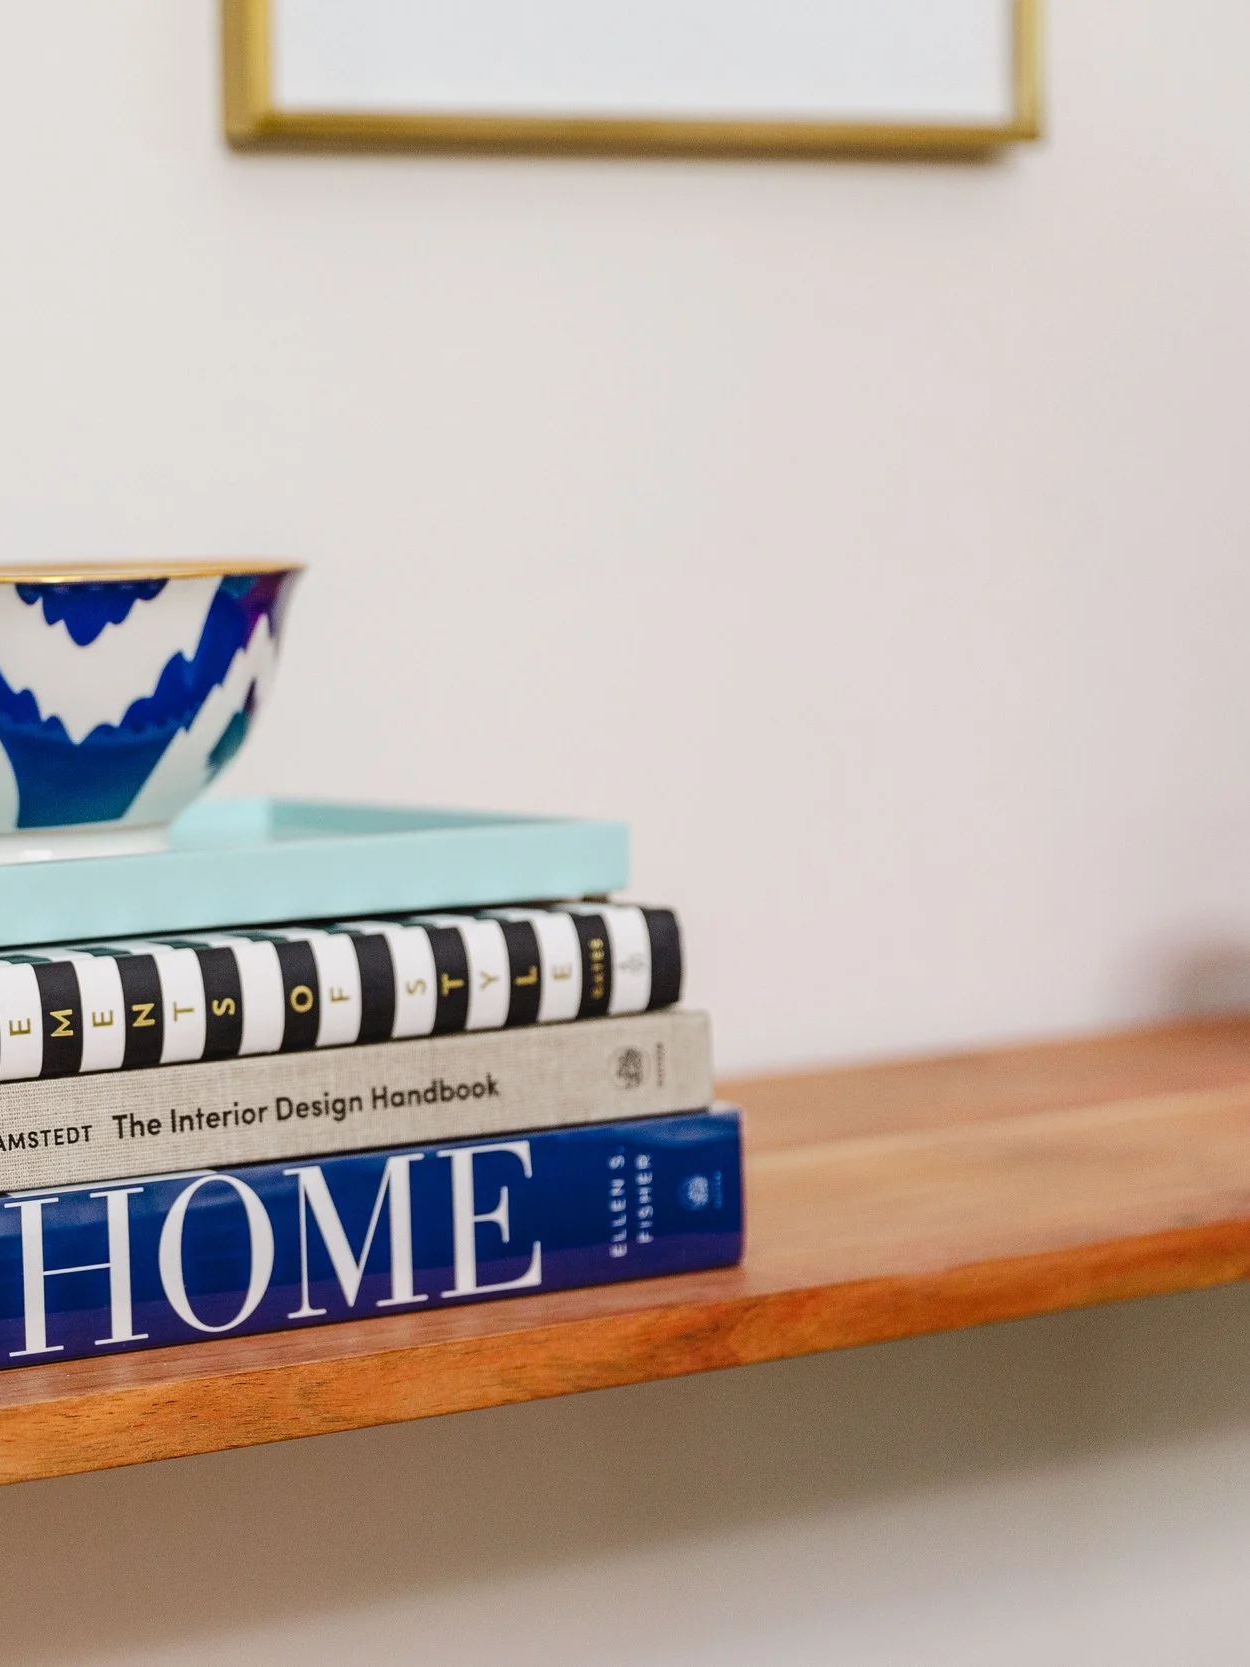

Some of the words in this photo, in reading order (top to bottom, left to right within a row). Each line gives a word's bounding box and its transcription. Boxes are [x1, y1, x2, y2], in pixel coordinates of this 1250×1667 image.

[290, 984, 351, 1013] OF
[406, 963, 573, 998] STYLE
[111, 1112, 163, 1140] The
[170, 1101, 269, 1133] Interior
[275, 1095, 363, 1122] Design
[371, 1071, 500, 1111] Handbook
[609, 1178, 628, 1258] ELLEN
[635, 1153, 654, 1244] FISHER
[3, 1139, 543, 1359] HOME
